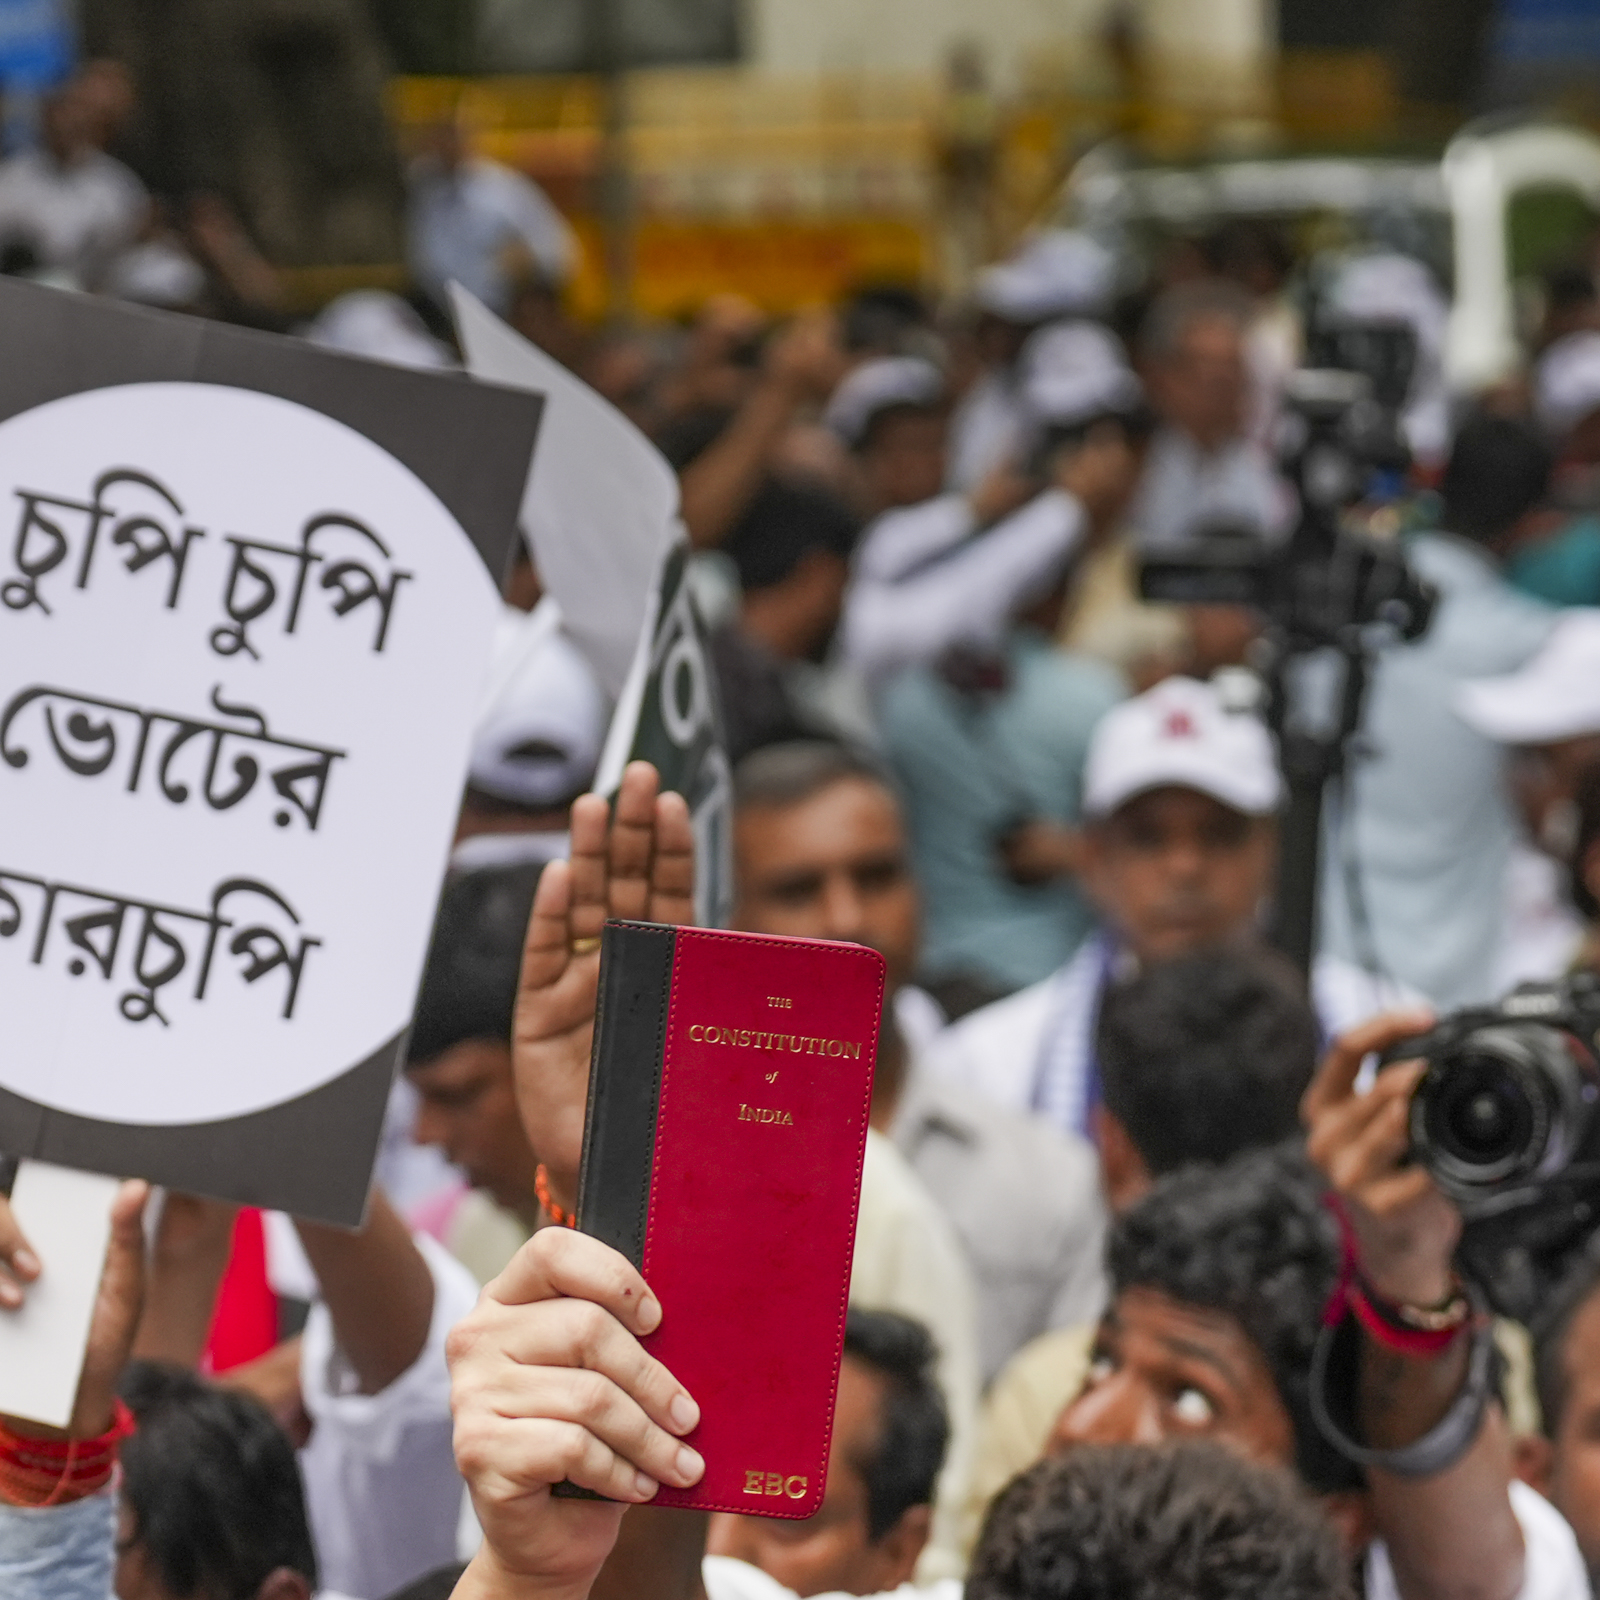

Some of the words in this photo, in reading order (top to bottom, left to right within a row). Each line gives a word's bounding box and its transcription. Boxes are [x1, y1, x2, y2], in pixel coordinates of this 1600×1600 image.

[0, 468, 205, 617] চুপি
[210, 512, 414, 660] চুপি
[766, 995, 793, 1010] THE
[688, 1024, 863, 1060] CONSTITUTION
[765, 1070, 780, 1085] of
[742, 1470, 808, 1499] EBC
